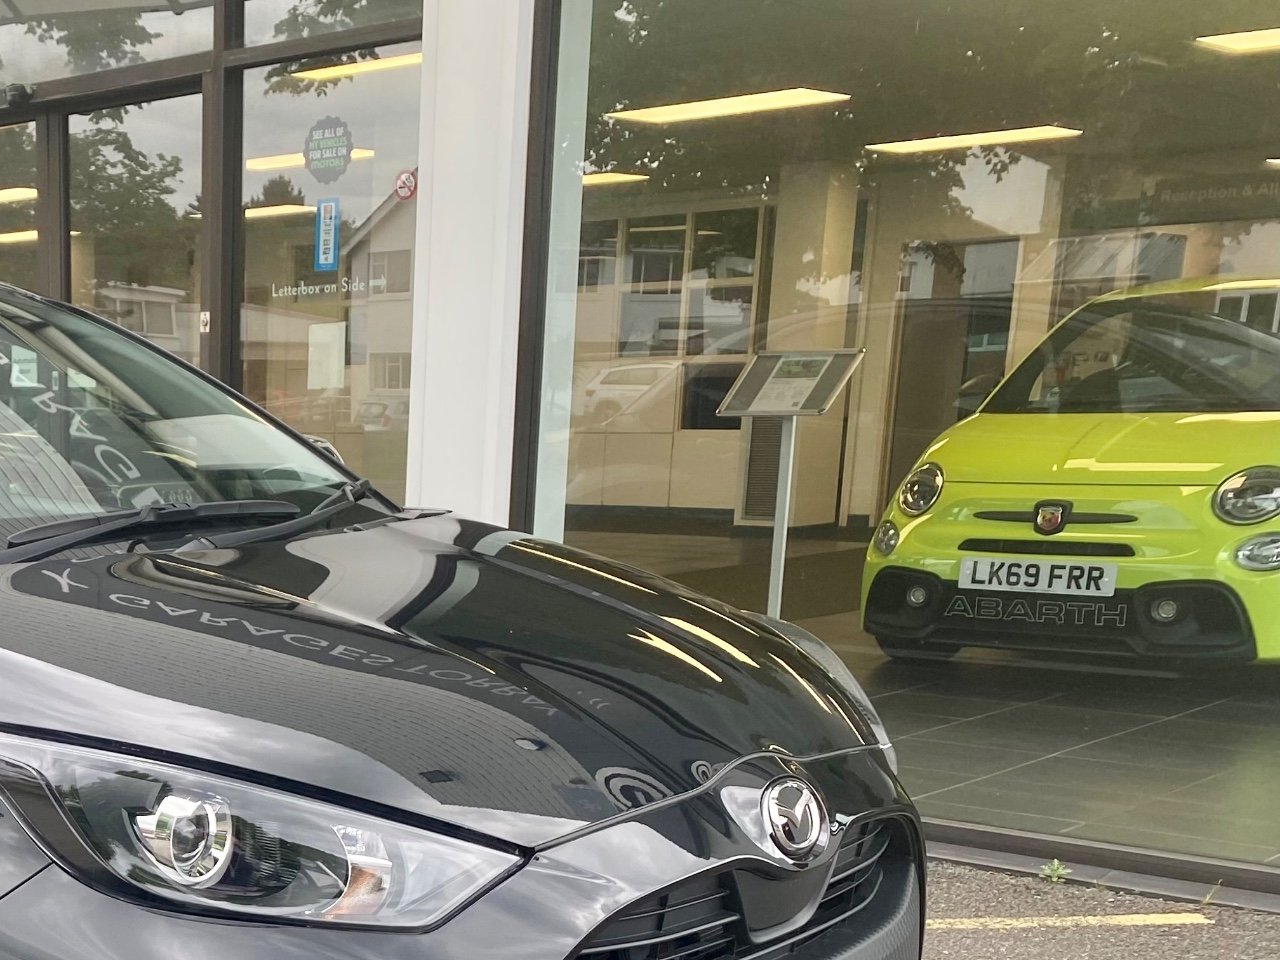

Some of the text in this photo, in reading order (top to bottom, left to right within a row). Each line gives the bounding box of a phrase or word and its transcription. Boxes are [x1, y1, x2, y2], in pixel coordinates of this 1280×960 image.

[312, 126, 345, 140] SEE ALL OF
[309, 150, 321, 160] FOR
[322, 148, 336, 159] SALE
[1242, 183, 1253, 196] &
[272, 276, 365, 297] Letterbox on Side
[971, 561, 1105, 591] LK69 FRR
[944, 595, 1128, 627] ABARTH
